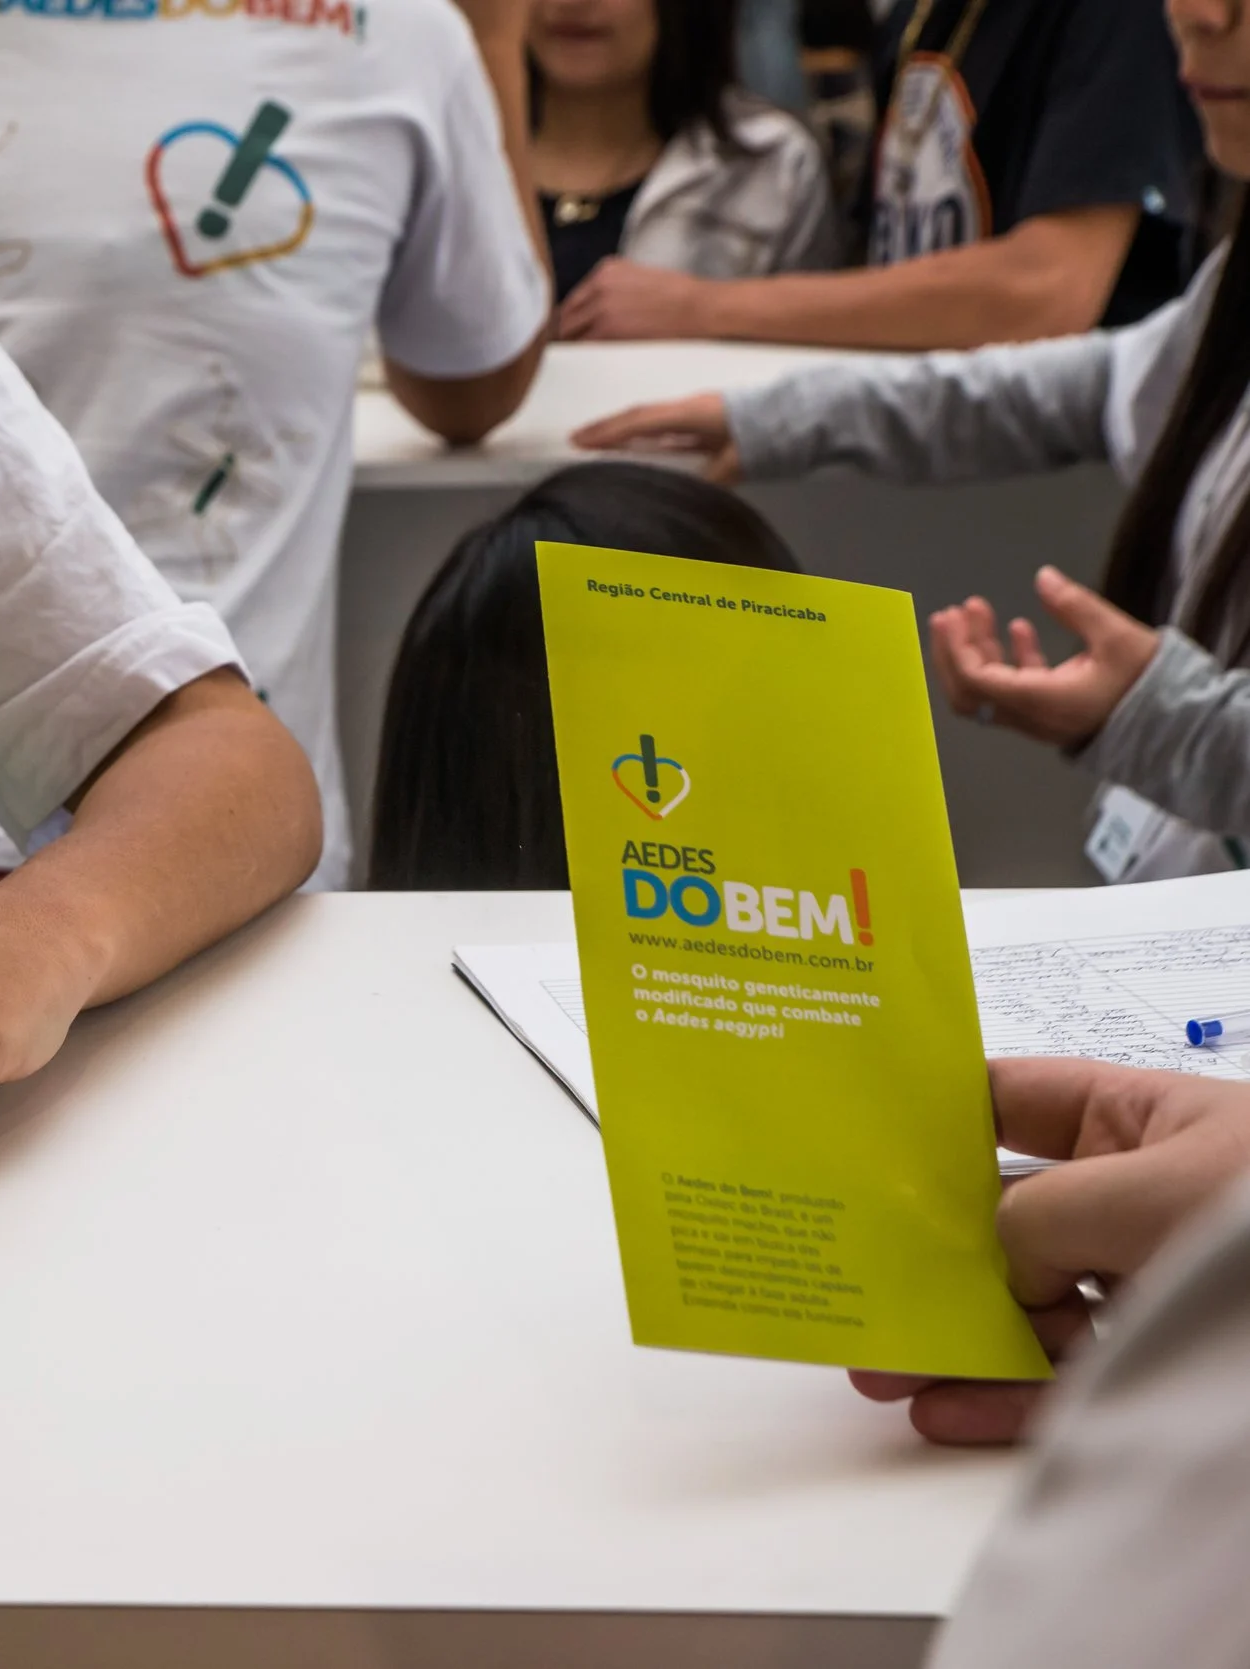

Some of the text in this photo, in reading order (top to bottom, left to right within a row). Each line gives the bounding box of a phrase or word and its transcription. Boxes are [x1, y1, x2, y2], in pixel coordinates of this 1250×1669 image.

[587, 579, 827, 622] Região Central de Piracicaba
[621, 839, 716, 875] AEDES
[628, 931, 875, 973] www.aedesdobem.com.br
[631, 963, 881, 1008] O mosquito geneticamente
[633, 986, 862, 1027] modificado que combate
[636, 1007, 785, 1040] o Aedes aegypti
